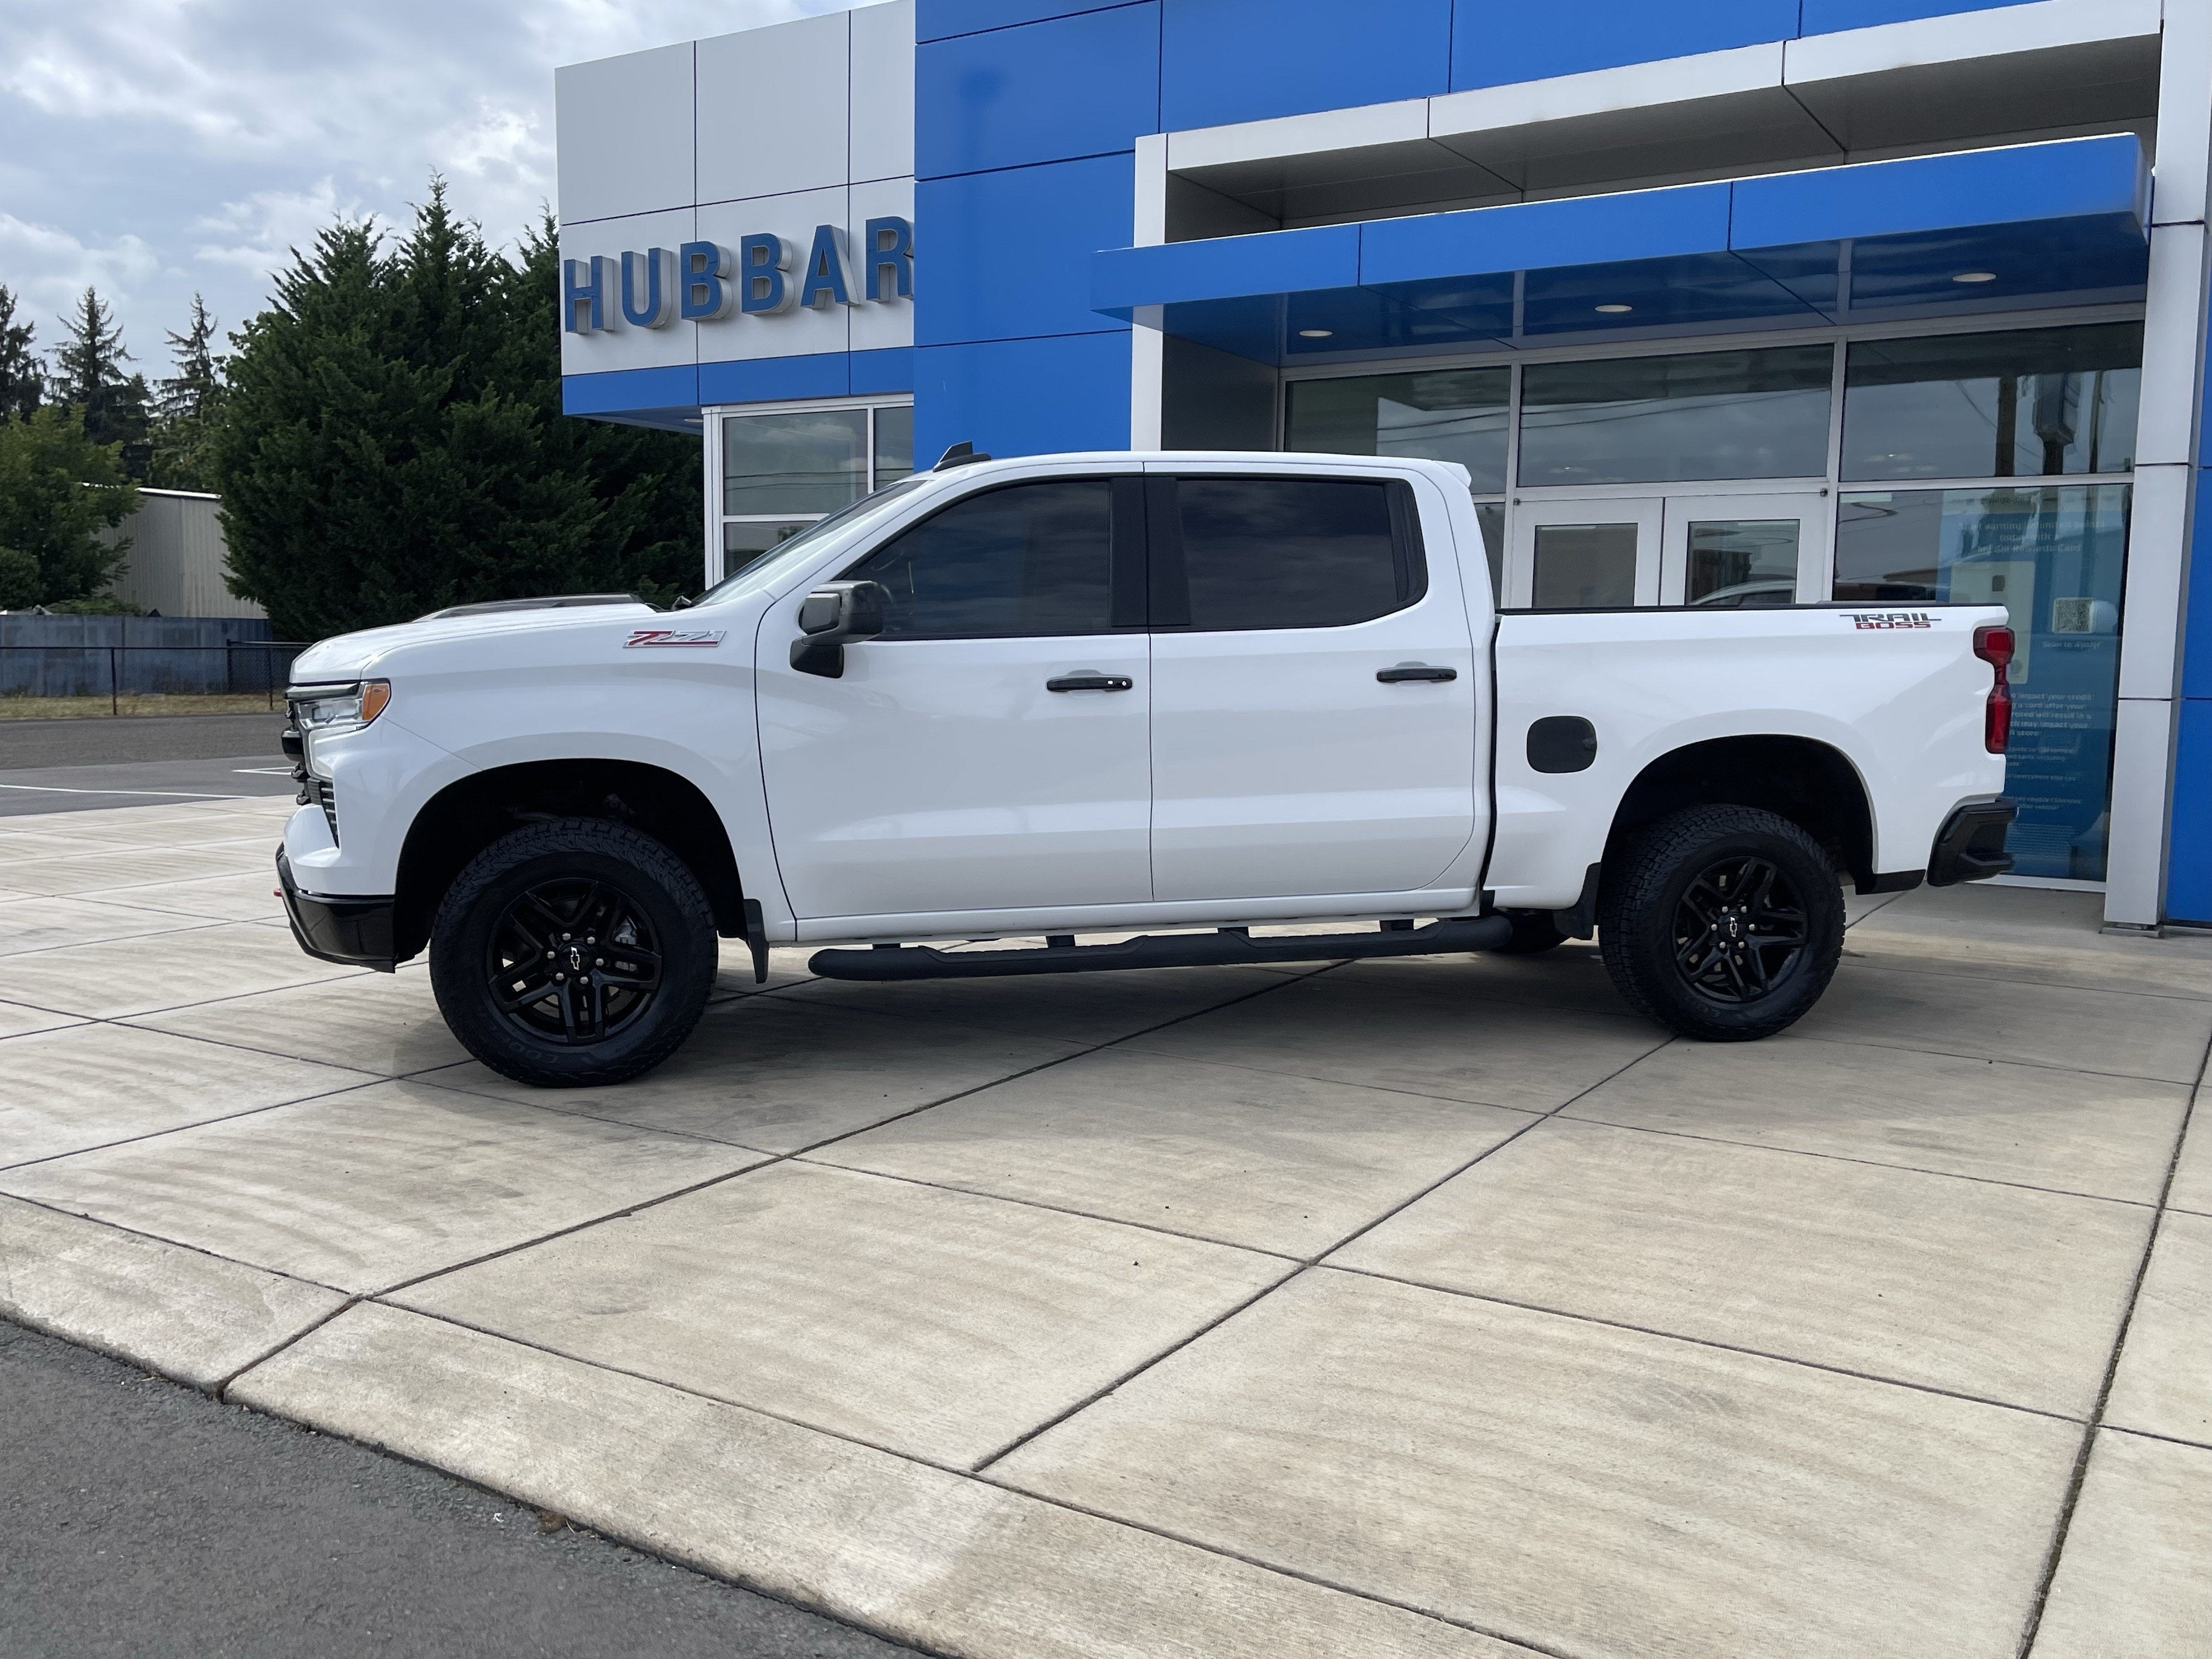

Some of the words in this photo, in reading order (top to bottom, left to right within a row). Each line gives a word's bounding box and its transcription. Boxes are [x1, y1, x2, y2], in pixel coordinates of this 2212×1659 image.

[564, 216, 915, 334] HUBBAR
[1839, 613, 1942, 622] TRAIL
[1855, 621, 1931, 629] BOSS
[623, 630, 727, 648] Z71
